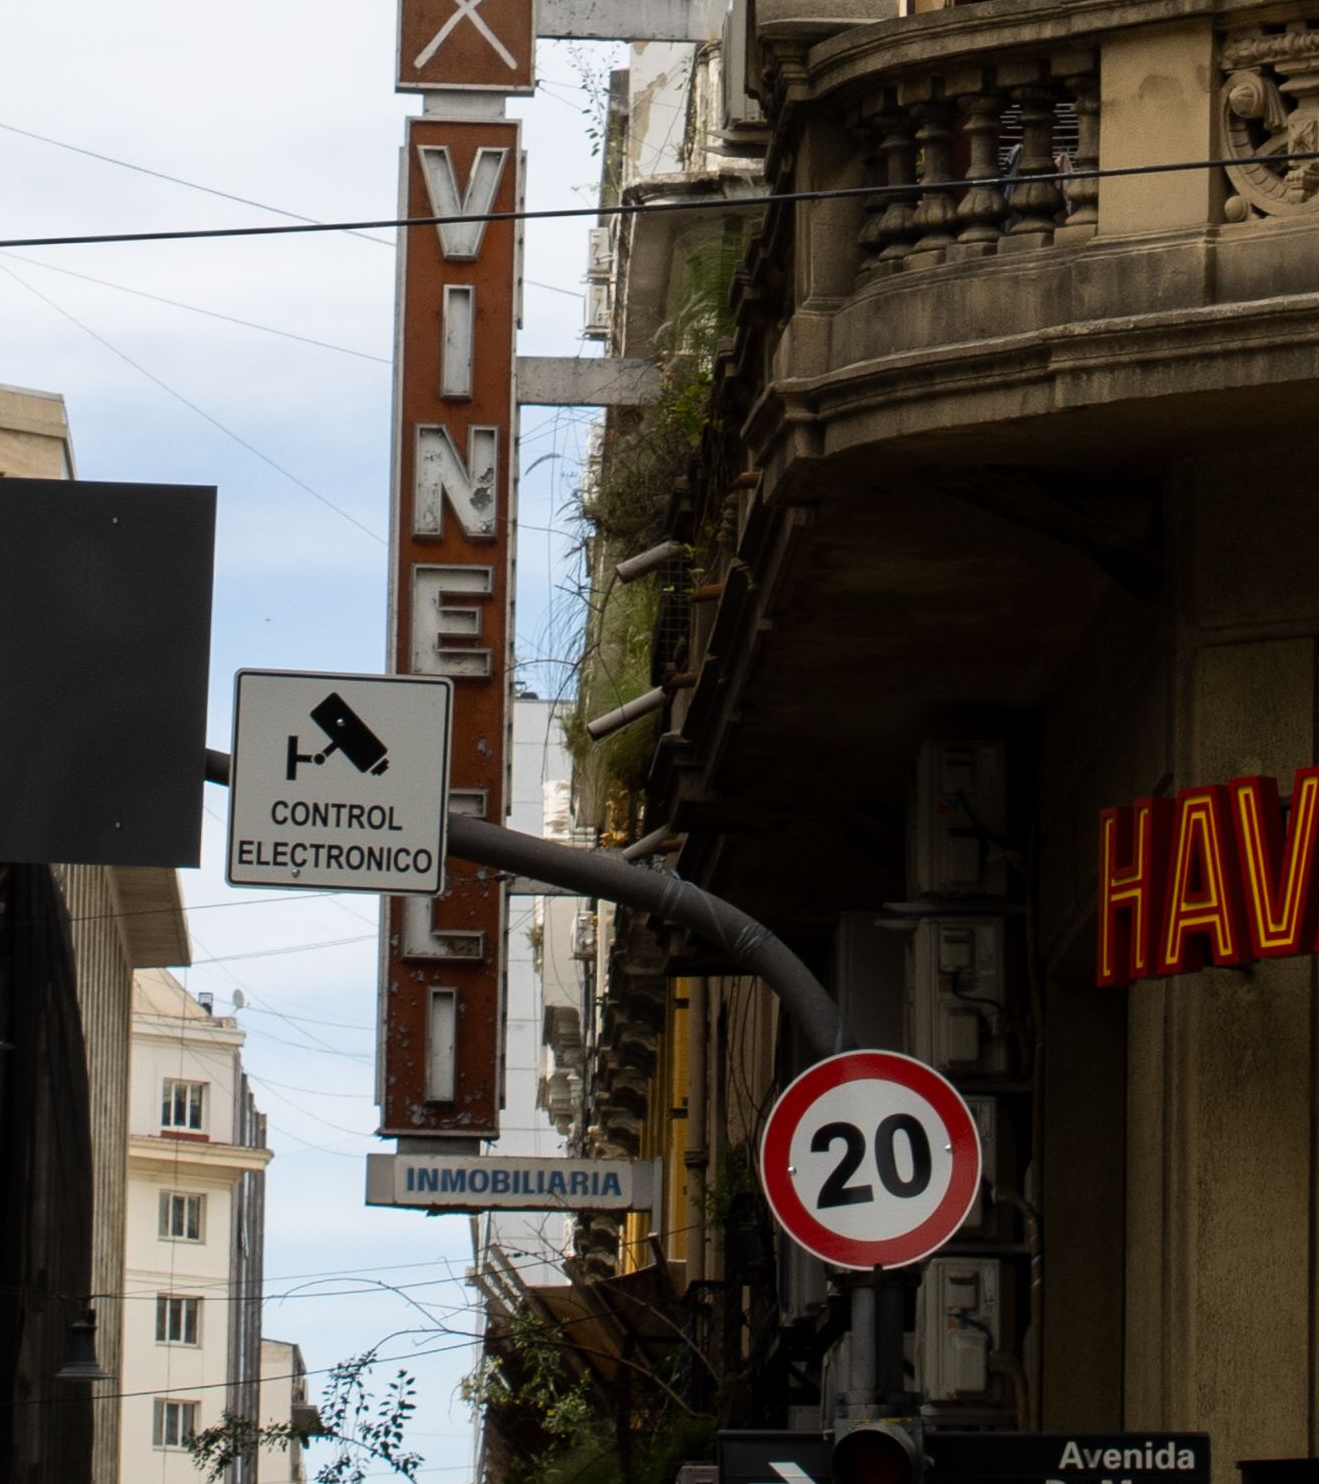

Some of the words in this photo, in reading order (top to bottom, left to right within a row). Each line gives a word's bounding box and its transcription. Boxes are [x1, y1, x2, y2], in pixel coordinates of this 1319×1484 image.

[402, 145, 510, 1105] VINELI
[271, 800, 403, 831] CONTROL
[238, 840, 432, 874] ELECTRONICO
[810, 1113, 932, 1210] 20
[407, 1167, 622, 1196] INMOBILIARIA
[1058, 1441, 1195, 1470] Avenida
